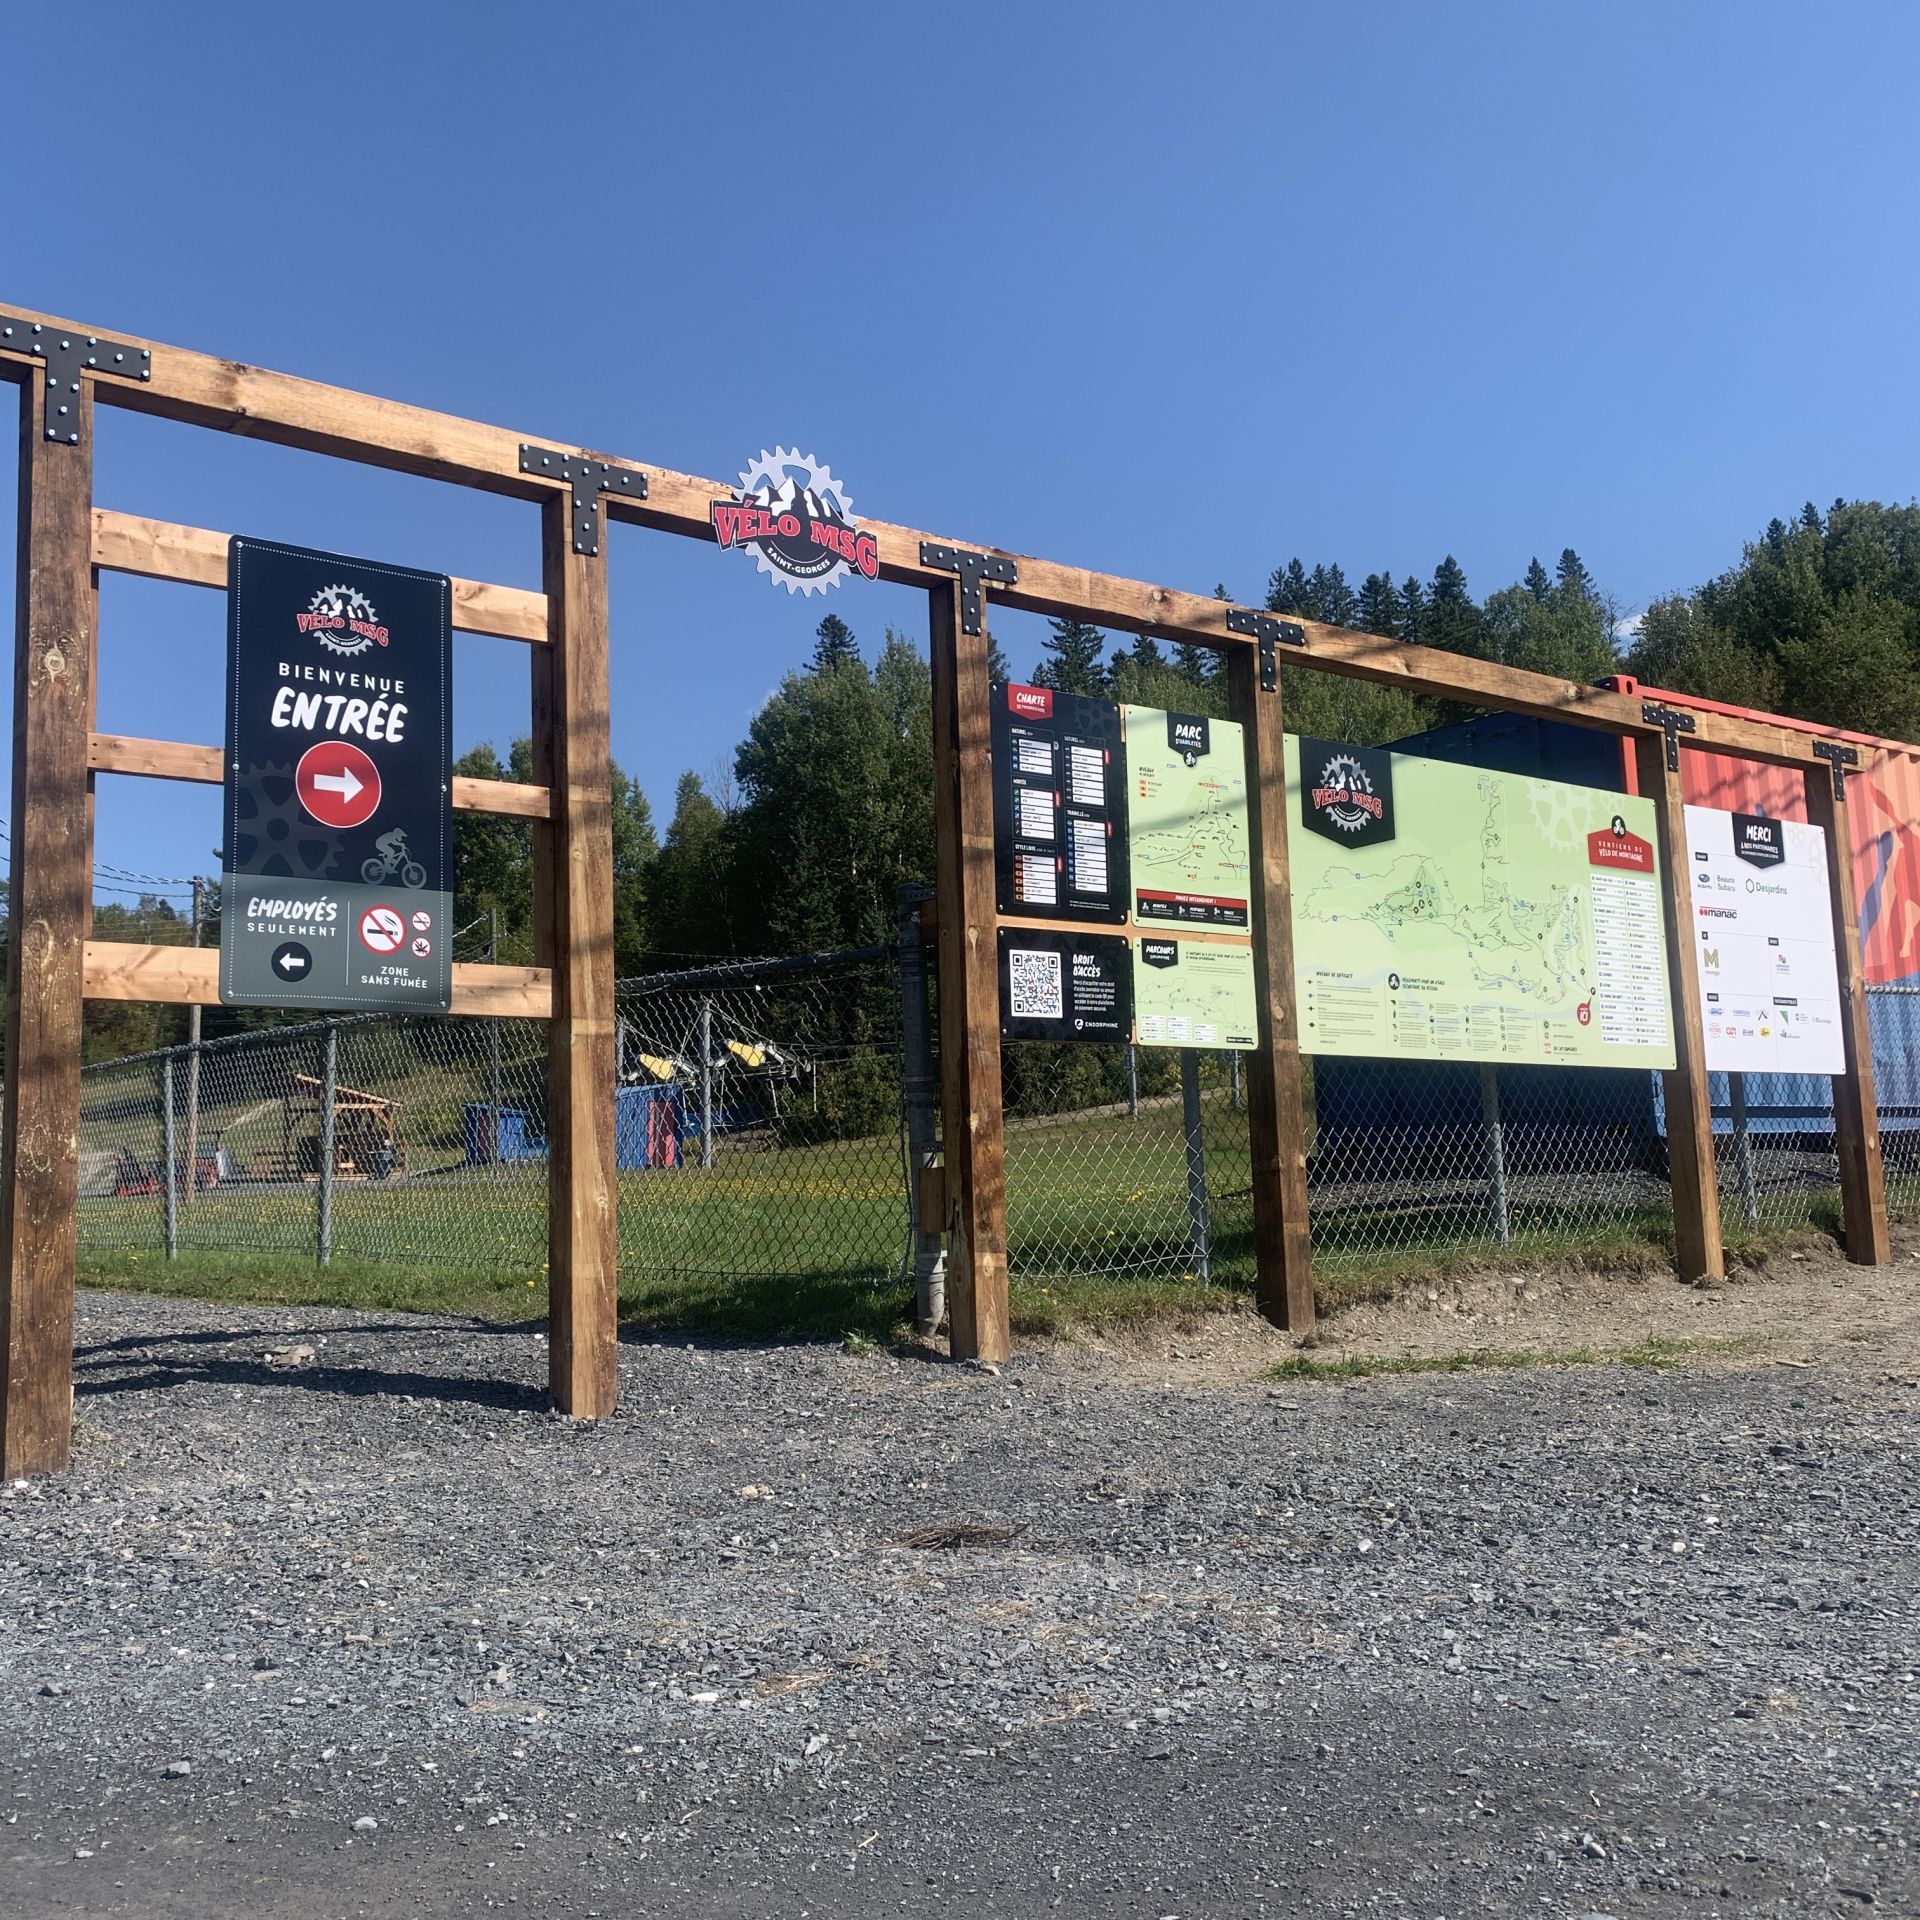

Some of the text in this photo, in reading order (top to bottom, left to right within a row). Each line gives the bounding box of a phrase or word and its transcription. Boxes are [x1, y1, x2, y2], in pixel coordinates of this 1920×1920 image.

[715, 500, 876, 577] VÉLO MSG
[767, 547, 831, 574] SAINT-GEORGES
[296, 610, 389, 647] VÉLO MSG
[279, 662, 405, 694] BIENVENUE
[1016, 692, 1046, 707] CHARTE
[271, 686, 408, 743] ENTRÉE
[1175, 724, 1202, 740] PARC
[1311, 784, 1383, 819] VÉLO MSG
[1746, 825, 1772, 843] MERCI
[1756, 882, 1788, 895] Desjardins
[247, 896, 338, 922] EMPLOYÉS
[1708, 909, 1738, 920] manac
[247, 922, 337, 937] SEULEMENT
[1146, 945, 1175, 955] PARCOURS
[1072, 954, 1095, 965] DROIT
[380, 966, 409, 977] ZONE
[361, 975, 428, 989] SANS FUMÉE
